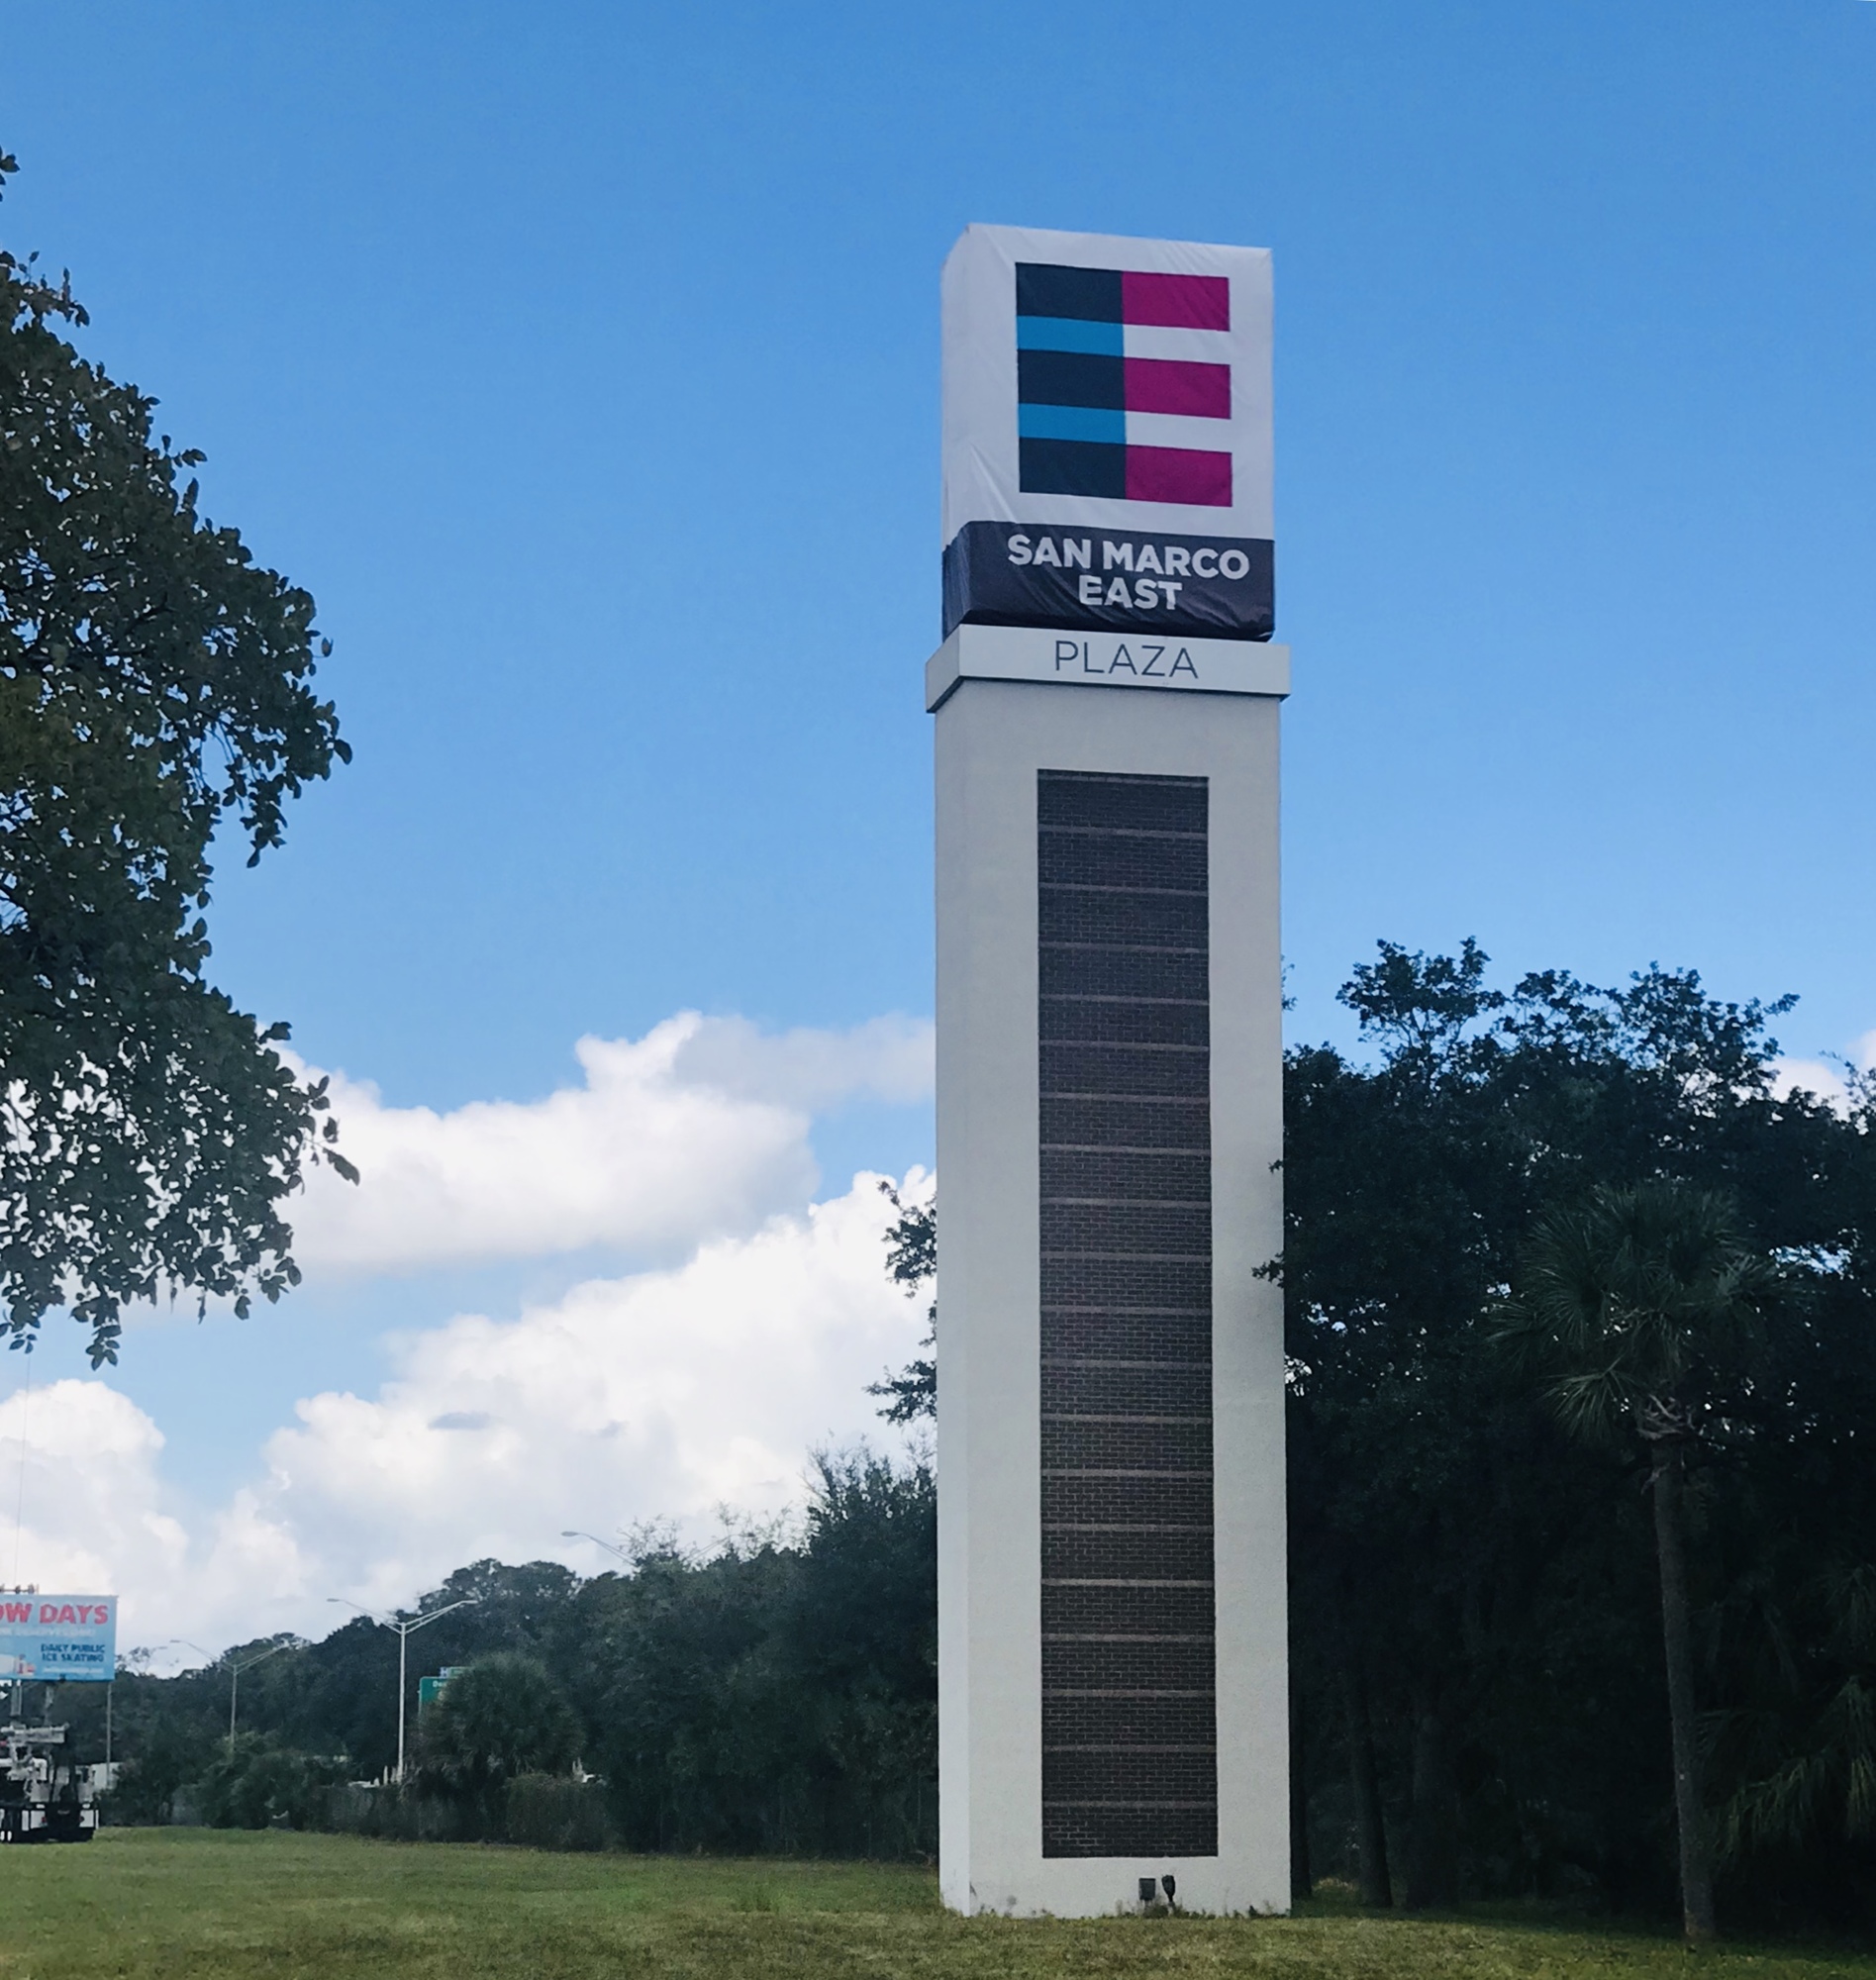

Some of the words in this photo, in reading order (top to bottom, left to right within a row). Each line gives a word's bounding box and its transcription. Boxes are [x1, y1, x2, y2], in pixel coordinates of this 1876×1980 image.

[1008, 534, 1091, 568] SAN
[1103, 541, 1250, 579] MARCO
[1078, 575, 1183, 610] EAST
[1055, 641, 1199, 679] PLAZA
[0, 1602, 33, 1623] W
[40, 1604, 109, 1625] DAYS
[42, 1653, 57, 1662] ICE
[71, 1643, 106, 1653] PUBLIC
